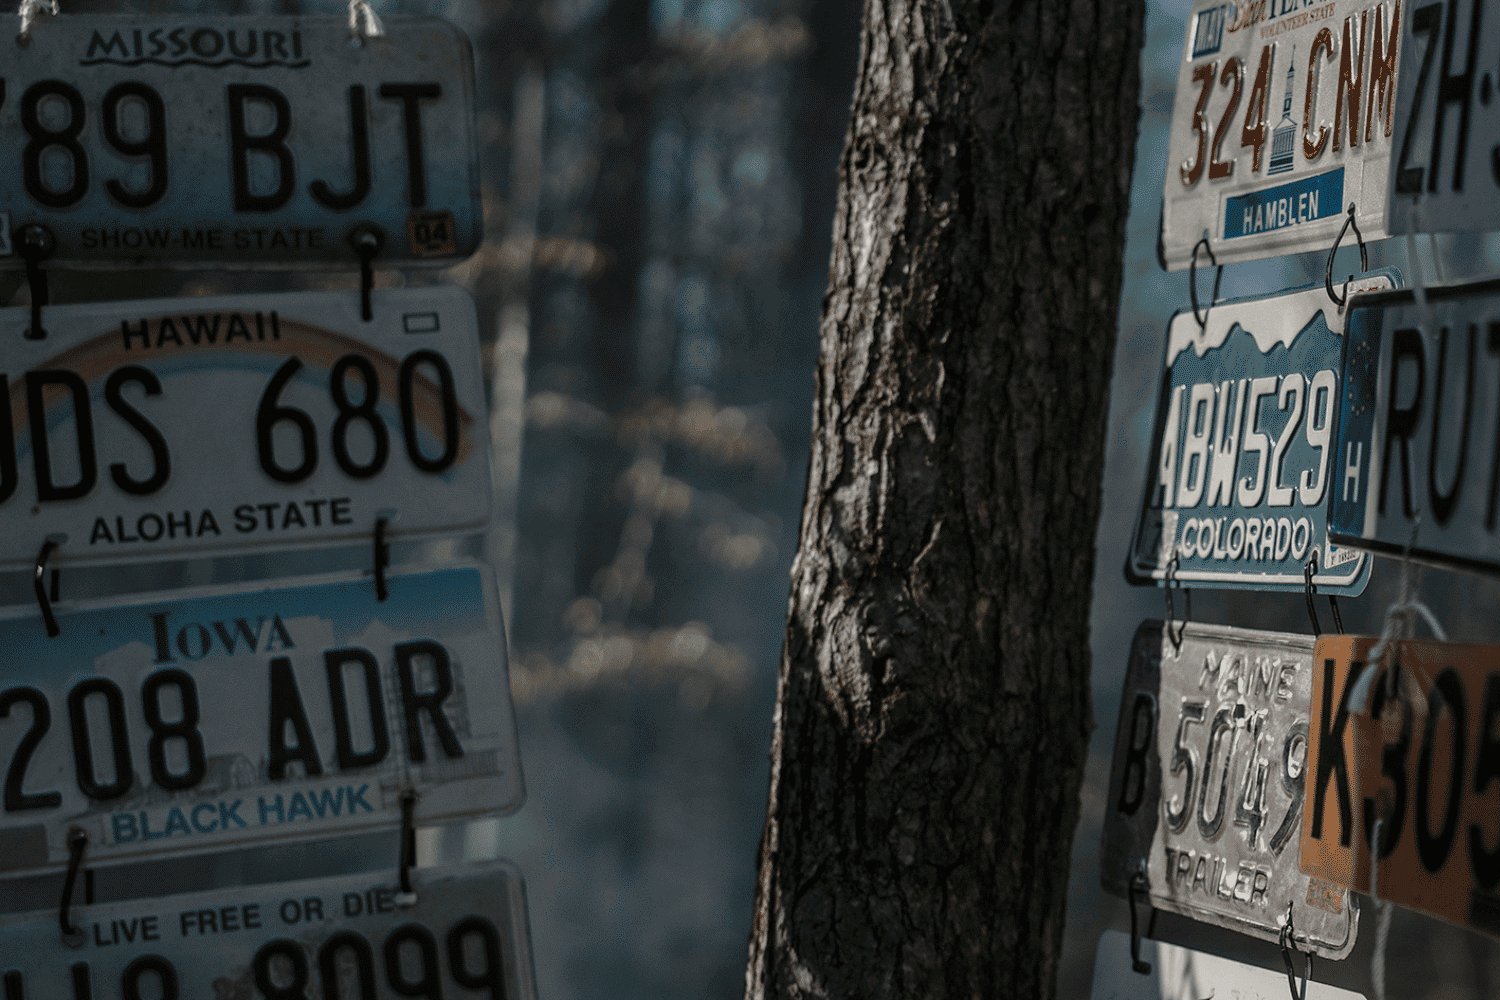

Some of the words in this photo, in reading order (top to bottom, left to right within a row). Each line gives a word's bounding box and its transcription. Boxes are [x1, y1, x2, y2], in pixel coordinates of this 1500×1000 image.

[86, 26, 304, 60] MISSOURI
[1181, 45, 1271, 185] 324
[0, 78, 169, 208] 89
[223, 82, 441, 213] BJT
[81, 228, 223, 252] SHOW-ME
[233, 227, 325, 251] STATE
[414, 221, 449, 245] 04
[1242, 189, 1320, 235] HAMBLEN
[121, 311, 281, 351] HAWAII
[256, 348, 460, 483] 680
[1159, 369, 1337, 508] ABW529
[1342, 441, 1363, 503] H
[90, 510, 221, 546] ALOHA
[233, 498, 353, 533] STATE
[1180, 516, 1311, 561] COLORADO
[1199, 650, 1301, 701] MAINE
[0, 666, 207, 813] 208
[267, 638, 465, 781] ADR
[111, 798, 247, 846] BLACK
[256, 783, 375, 829] HAWK
[1165, 847, 1272, 906] TRAILER
[93, 916, 160, 949] LIVE
[180, 904, 263, 938] FREE
[279, 896, 325, 925] OR
[343, 889, 397, 920] DIE
